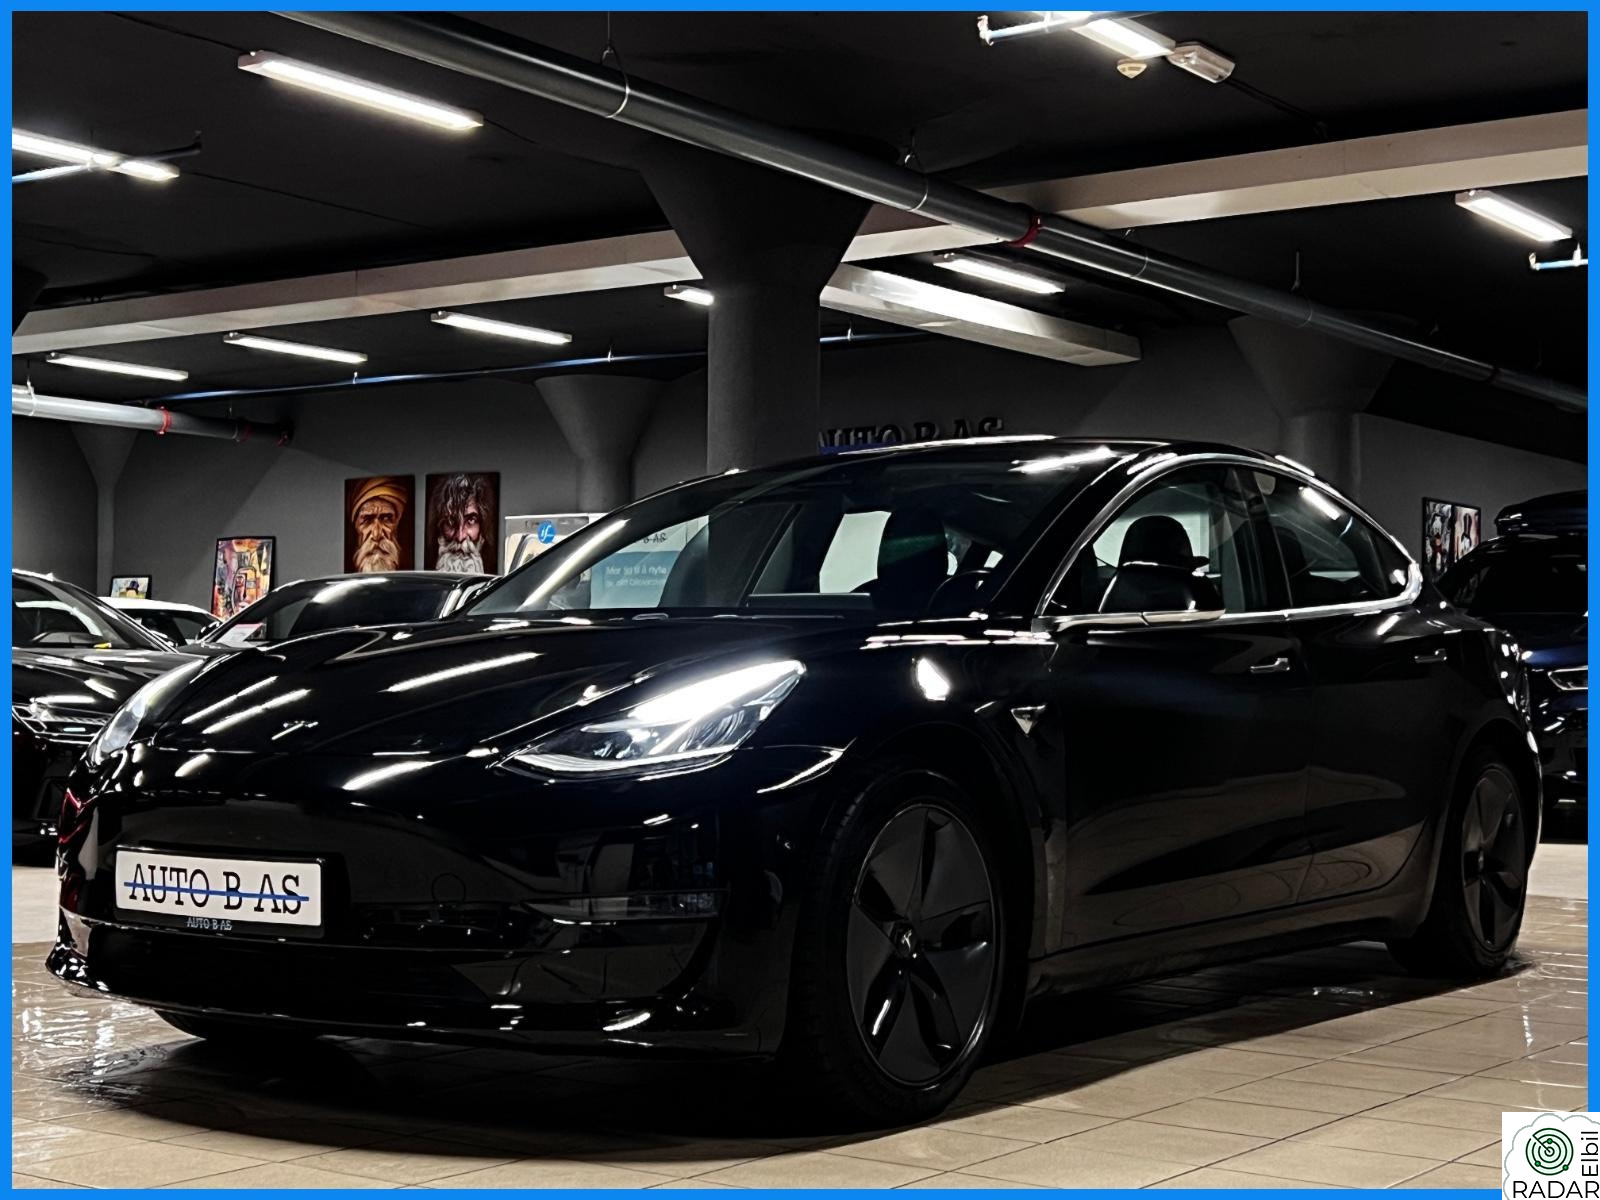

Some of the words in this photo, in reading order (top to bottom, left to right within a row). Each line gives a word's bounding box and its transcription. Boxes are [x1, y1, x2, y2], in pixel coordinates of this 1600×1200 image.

[129, 863, 210, 908] AUTO
[222, 871, 243, 910] B
[253, 873, 302, 915] AS
[185, 916, 210, 929] AUTO
[220, 919, 232, 931] AS
